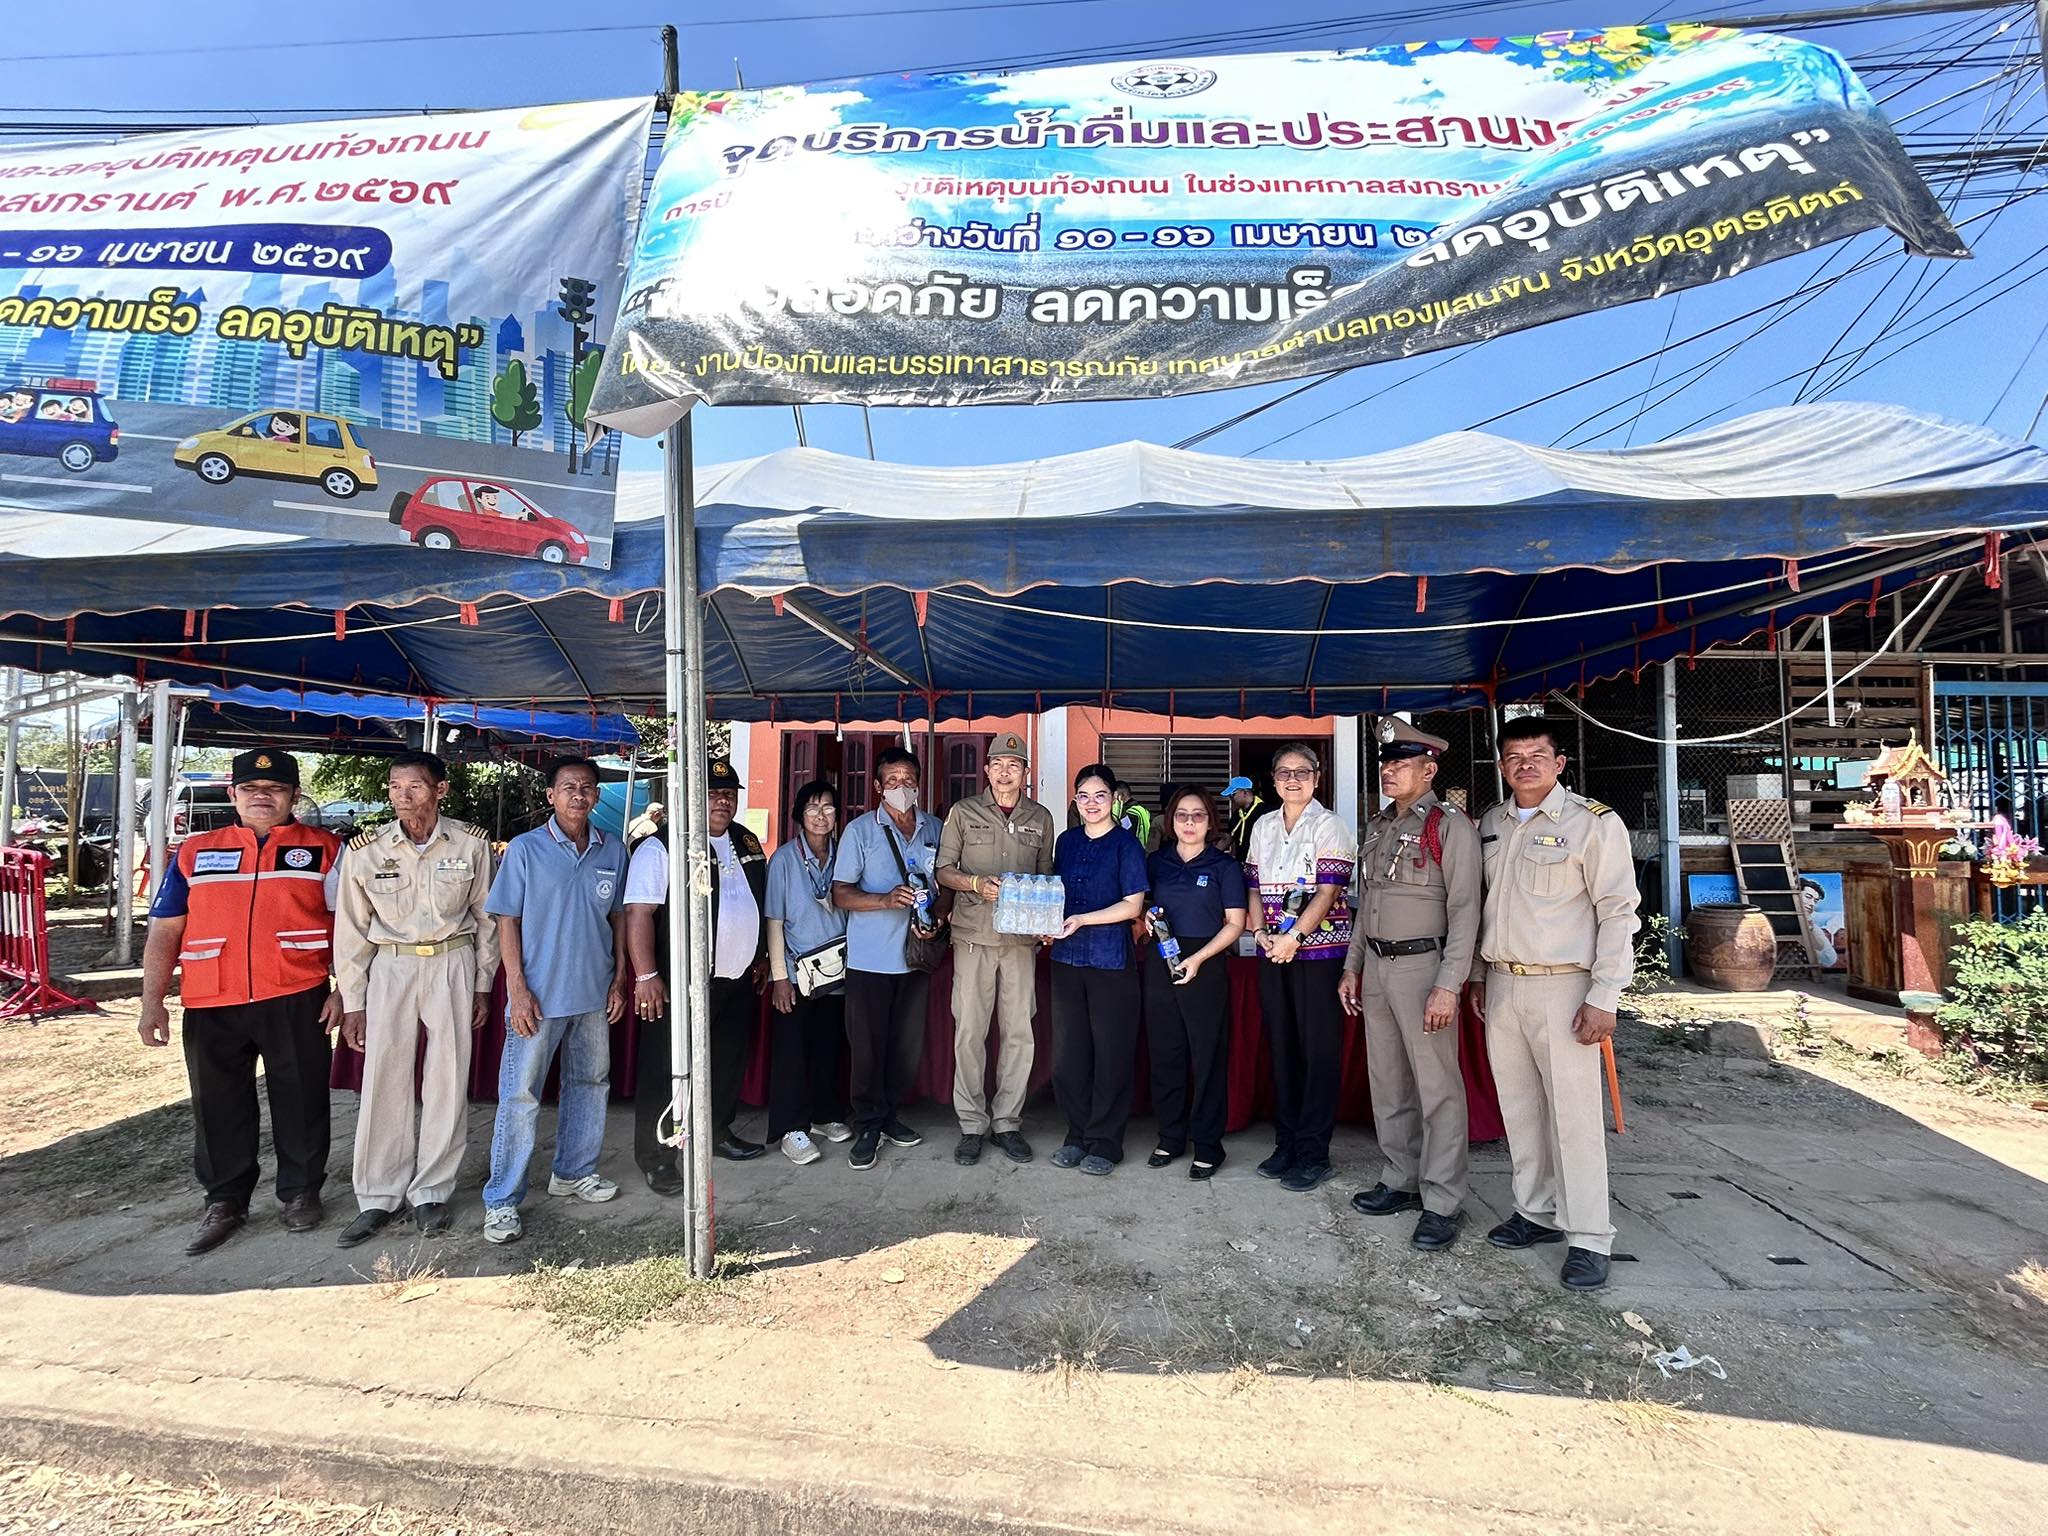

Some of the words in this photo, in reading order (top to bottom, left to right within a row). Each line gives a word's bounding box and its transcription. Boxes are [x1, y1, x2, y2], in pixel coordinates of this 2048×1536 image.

[0, 182, 210, 213] สงกรานต์
[220, 178, 459, 208] พ.ศ.๒๕๖๙
[1184, 173, 1518, 197] ในช่วงเทศกาลสงกราน
[1233, 224, 1377, 248] เมษายน
[1559, 181, 1864, 283] จังหวัดอุตรดิตถ์
[97, 240, 233, 264] เมษายน
[252, 243, 371, 272] ๒๕๖๙
[216, 299, 484, 378] ลดอุบัติเหตุ”
